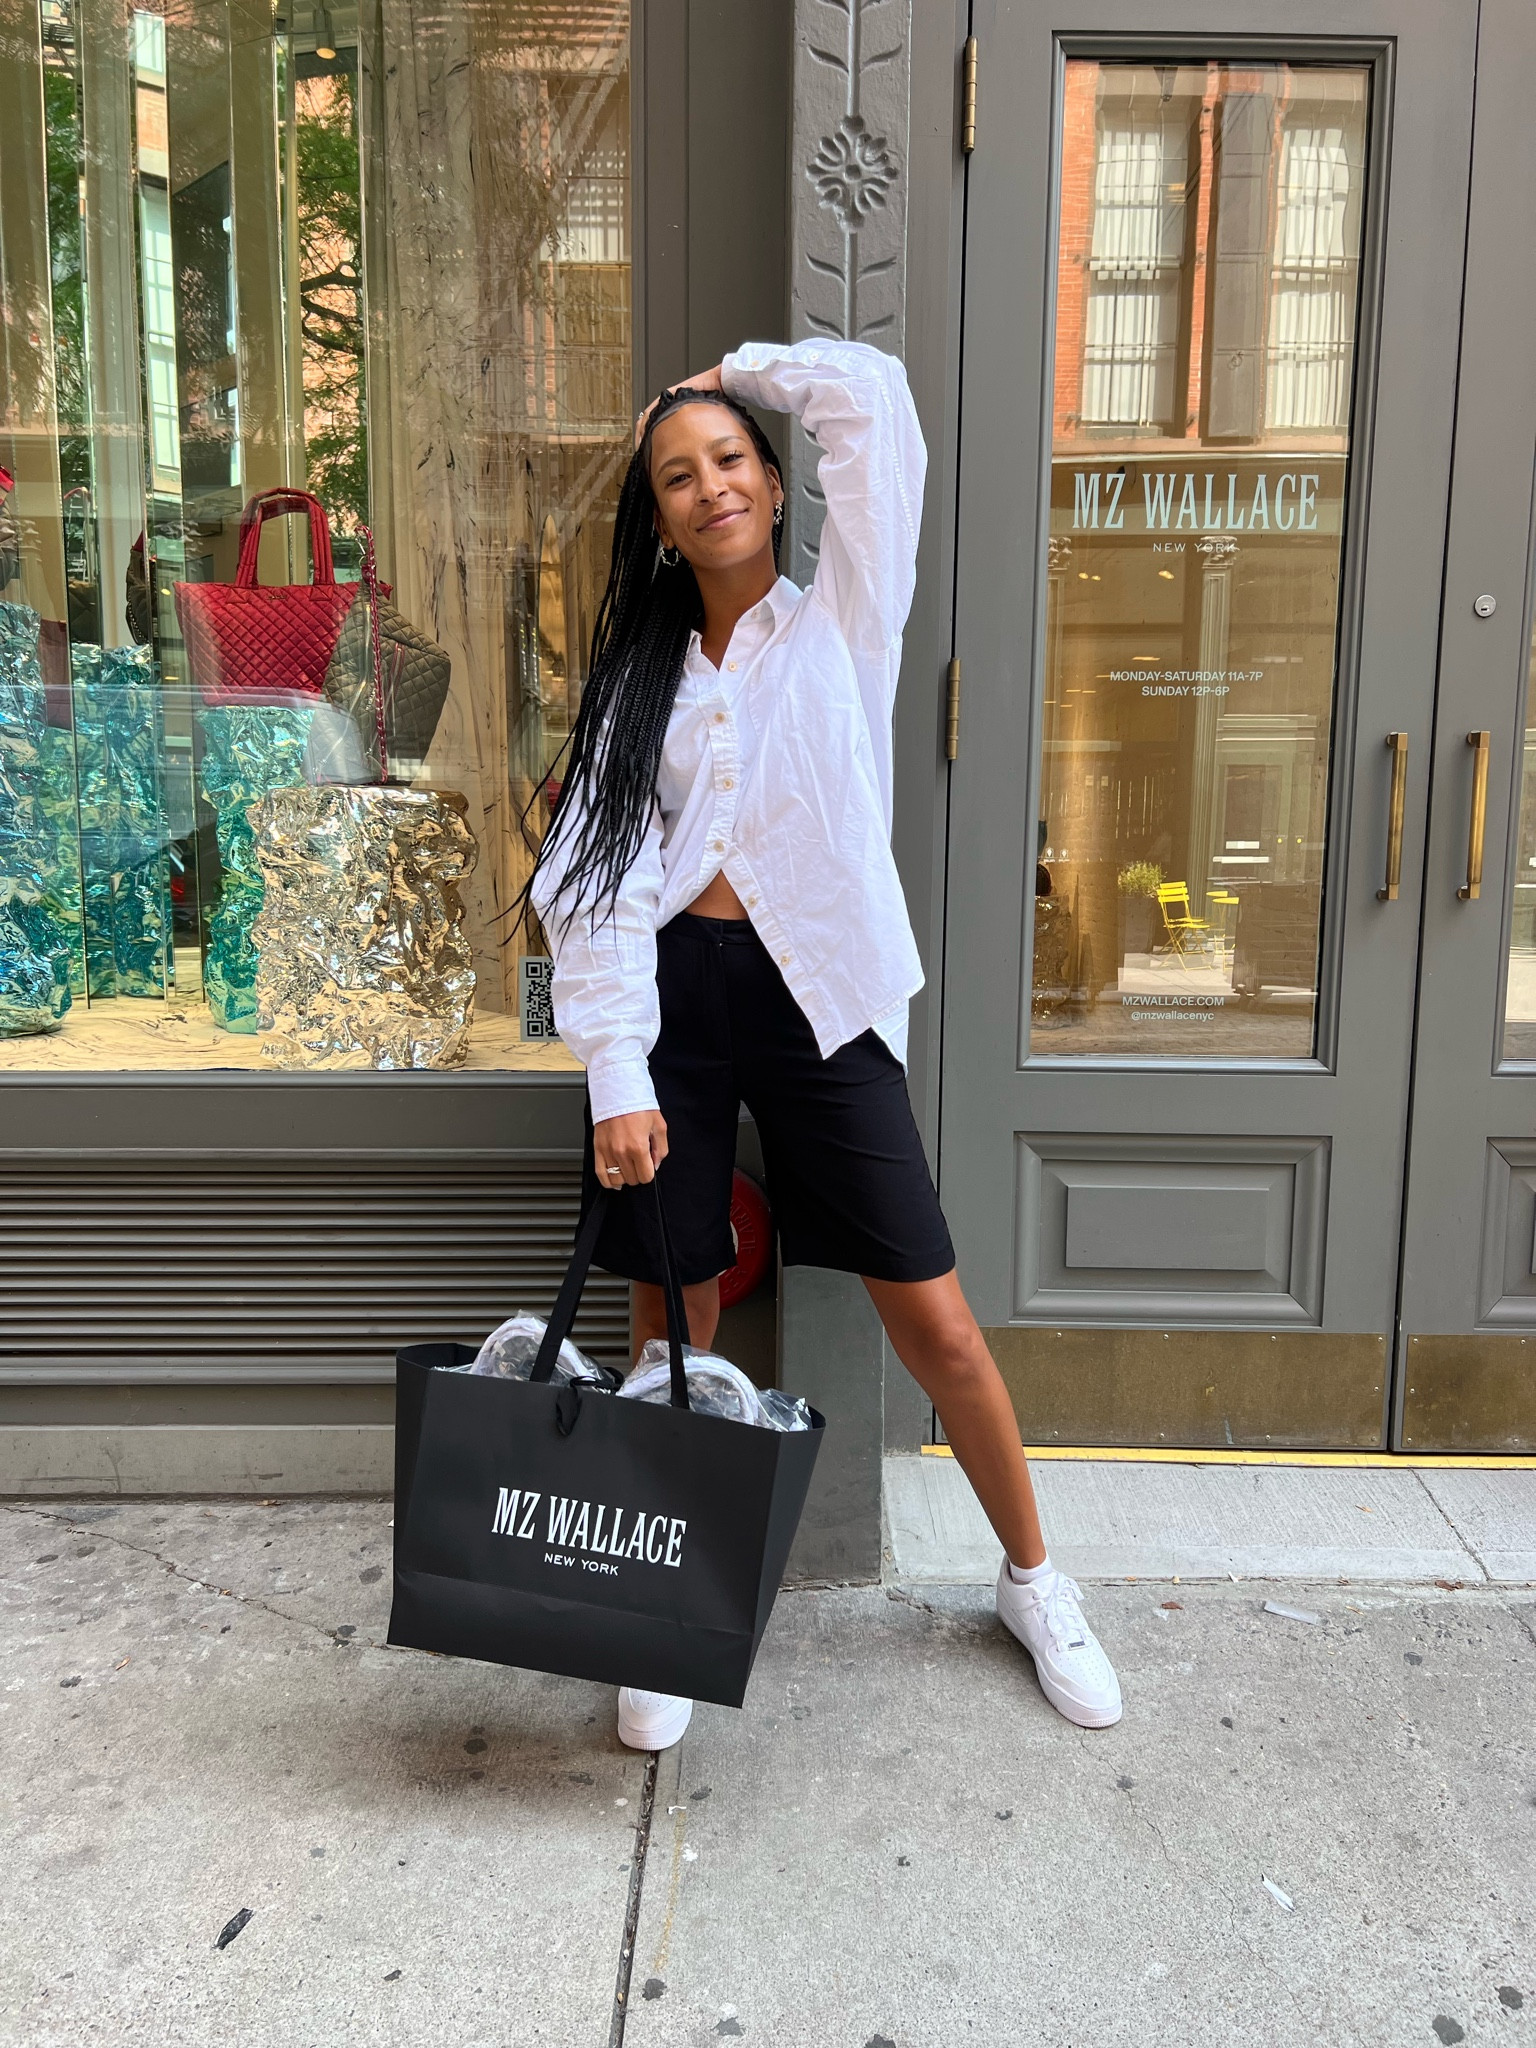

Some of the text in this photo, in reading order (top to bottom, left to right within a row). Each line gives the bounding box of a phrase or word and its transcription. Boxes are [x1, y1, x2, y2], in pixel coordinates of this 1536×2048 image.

[1072, 472, 1320, 531] MZ WALLACE
[1152, 542, 1236, 553] NEW YORK
[1109, 670, 1263, 682] MONDAY-SATURDAY 11A-7P
[1141, 685, 1230, 697] SUNDAY 12P-6P
[1122, 996, 1224, 1006] MZWALLACE.COM
[1131, 1010, 1214, 1021] @mzwallacenyc
[491, 1486, 688, 1568] MZ WALLACE
[544, 1552, 619, 1576] NEW YORK
